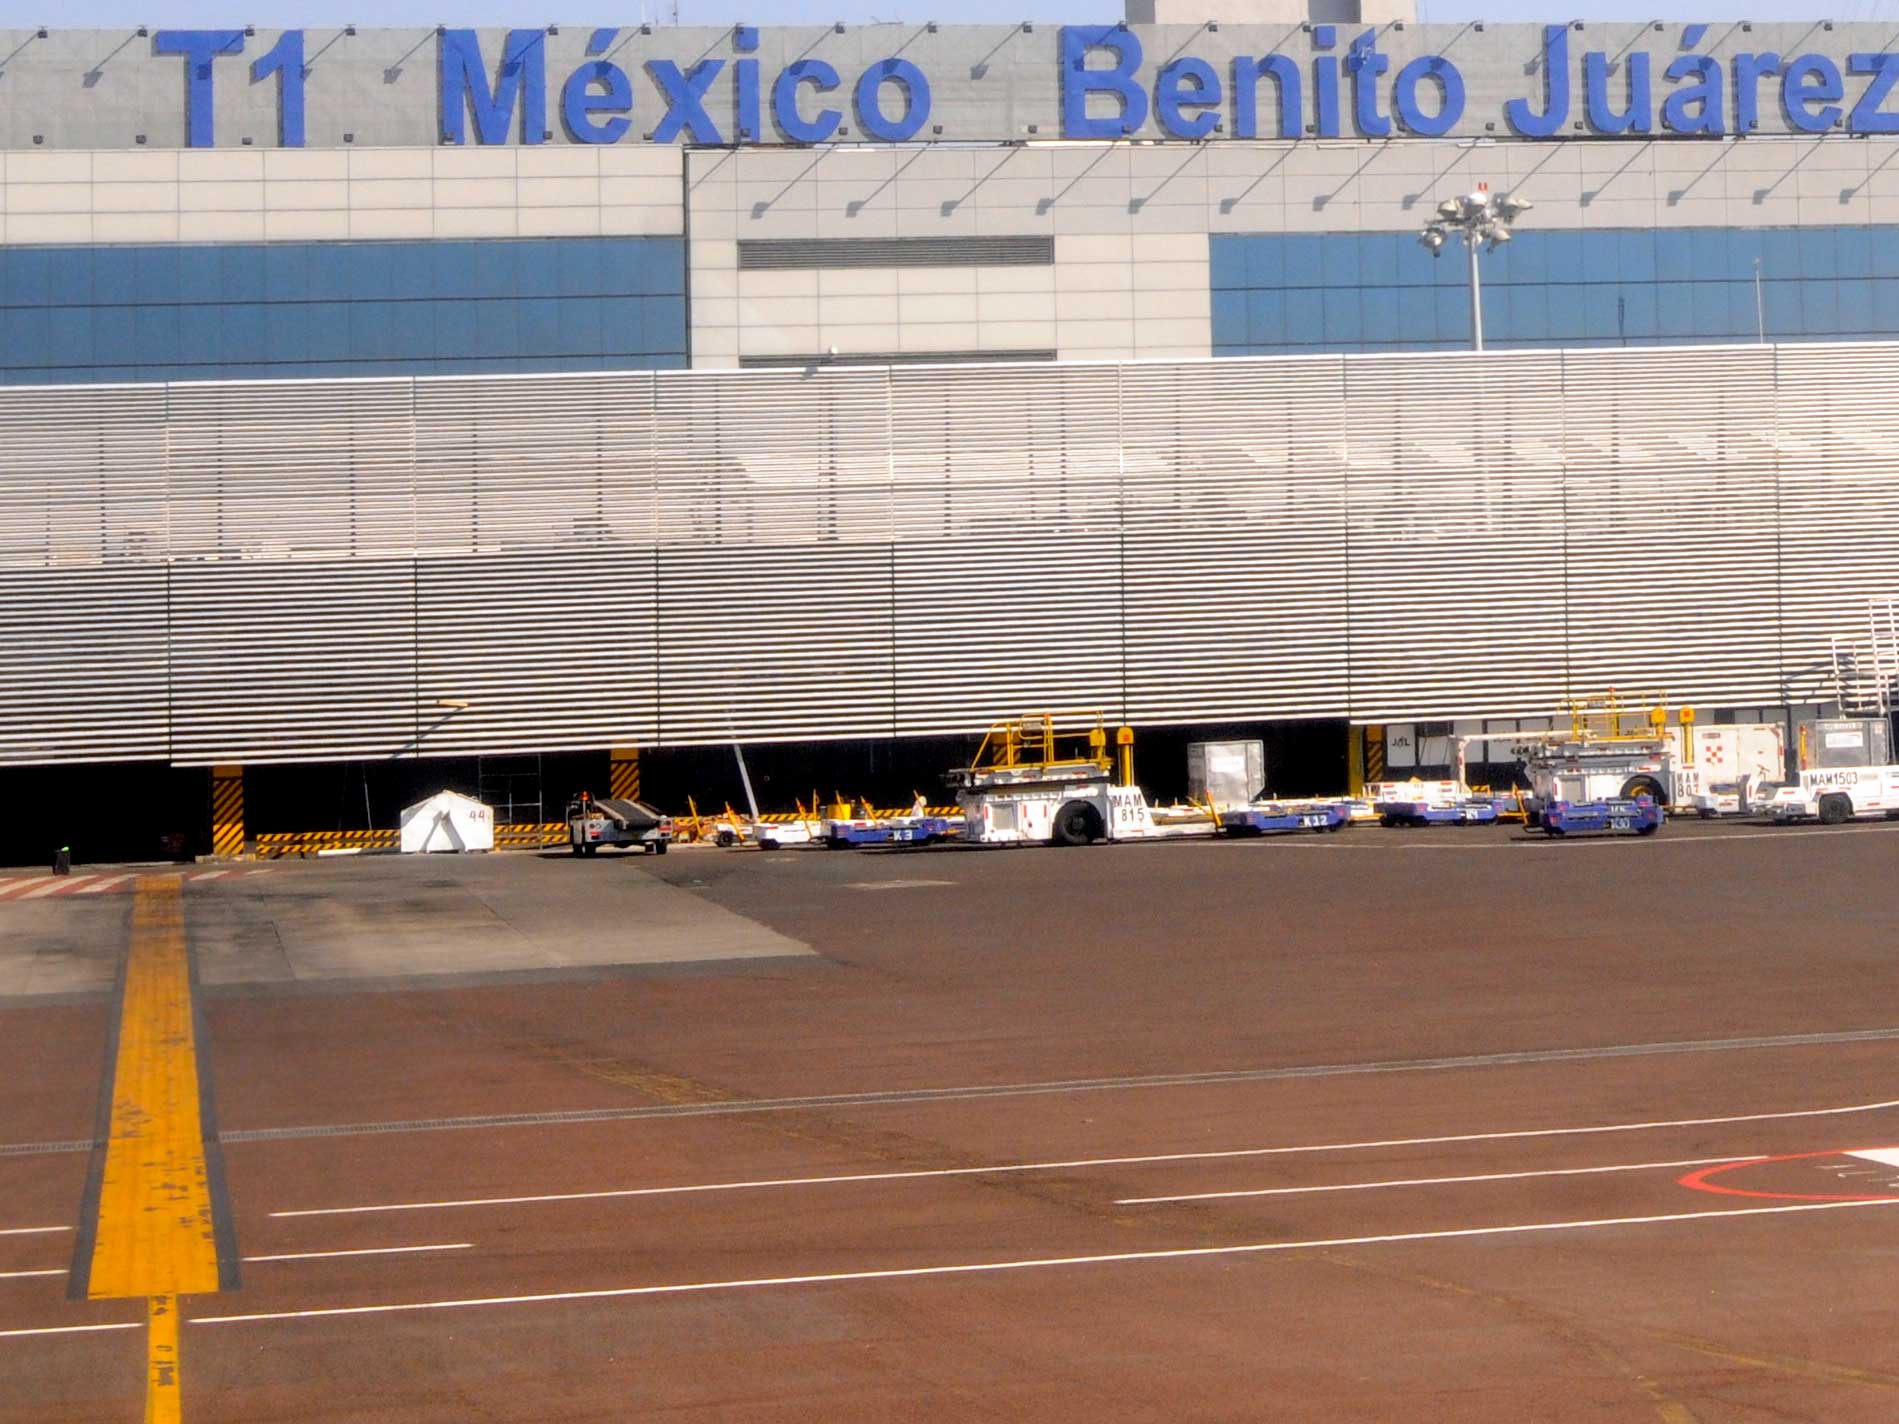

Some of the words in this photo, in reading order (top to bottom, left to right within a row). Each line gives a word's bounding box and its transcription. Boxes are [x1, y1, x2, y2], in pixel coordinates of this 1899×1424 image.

[154, 28, 306, 149] T1
[439, 26, 933, 147] México
[1060, 23, 1467, 140] Benito
[1809, 771, 1858, 786] MAM1503
[1112, 794, 1143, 807] MAM
[1121, 807, 1145, 822] 815
